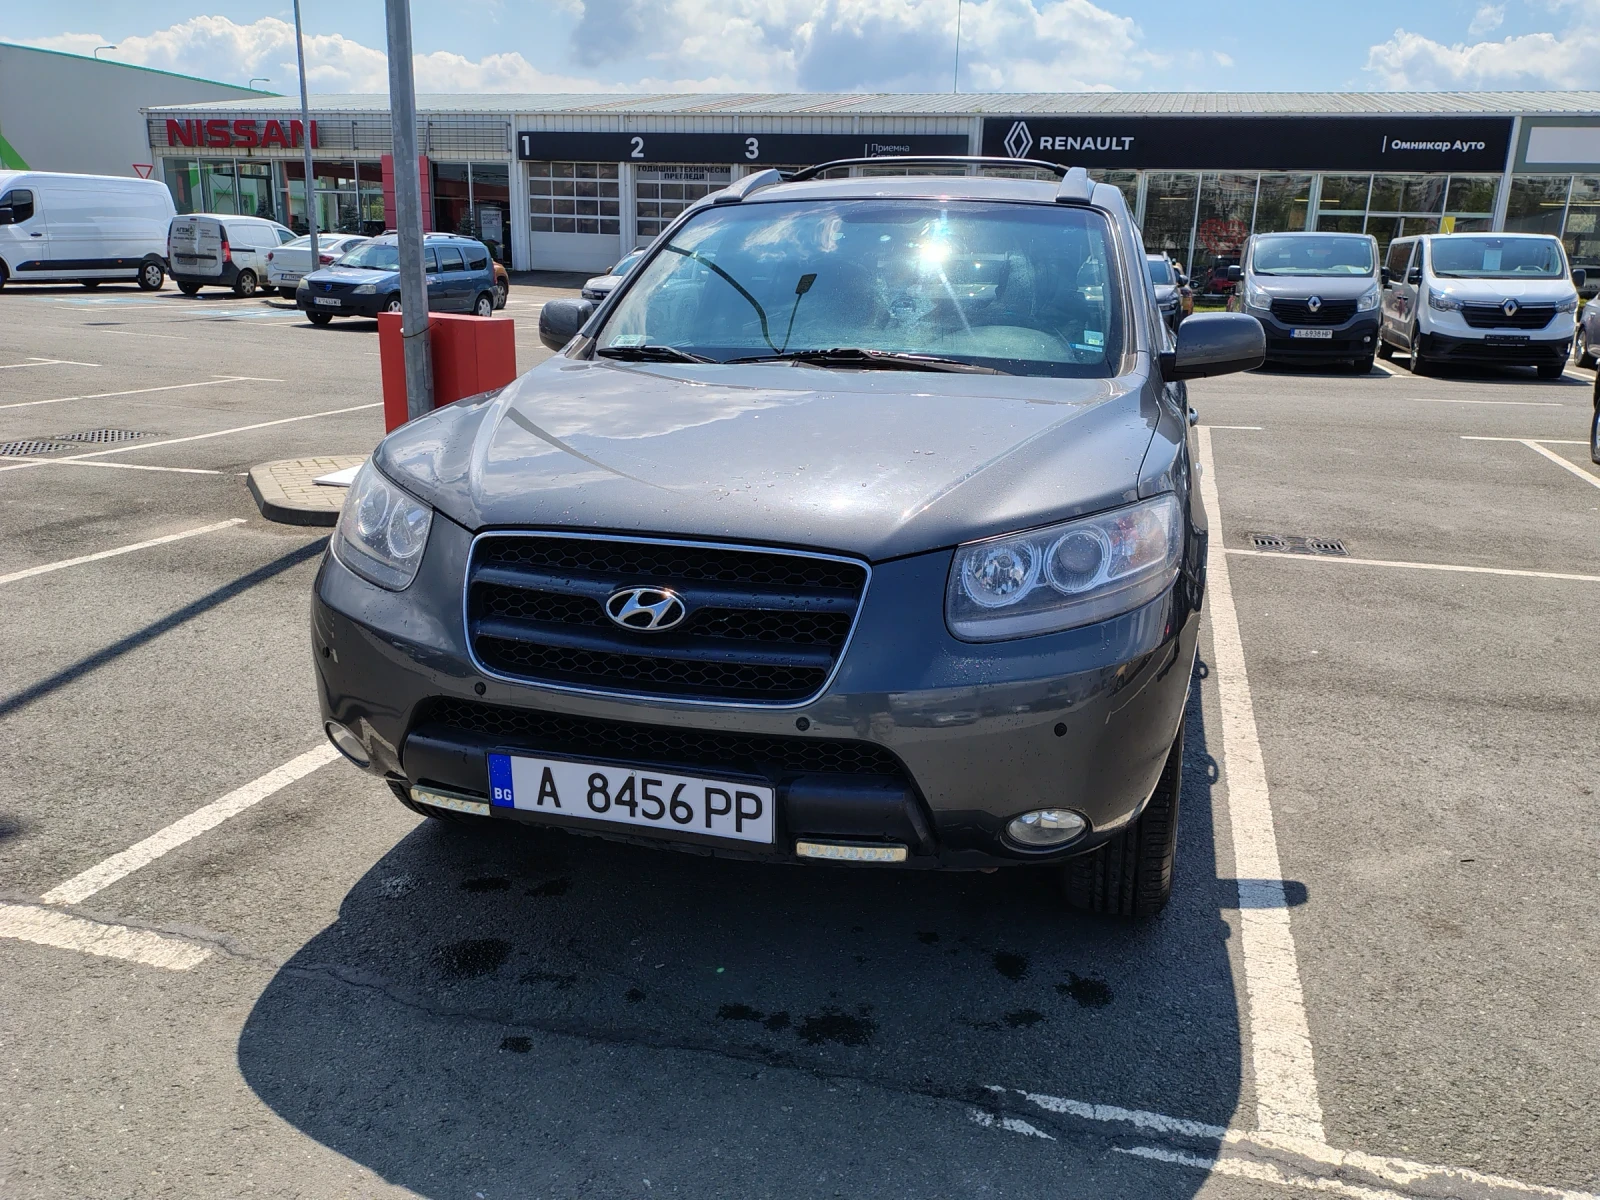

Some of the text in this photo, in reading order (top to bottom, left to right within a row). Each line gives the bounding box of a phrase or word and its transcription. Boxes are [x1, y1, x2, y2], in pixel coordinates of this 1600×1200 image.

[166, 119, 318, 148] NISSAN
[521, 135, 530, 156] 1
[630, 136, 645, 158] 2
[745, 137, 759, 159] 3
[871, 143, 910, 153] Приемна
[1039, 136, 1135, 151] RENAULT
[1391, 140, 1486, 152] Омникар Ауто
[680, 165, 731, 174] ТЕХНИЧЕСКИ
[494, 786, 512, 801] BG
[536, 766, 763, 833] A 8456 PP
